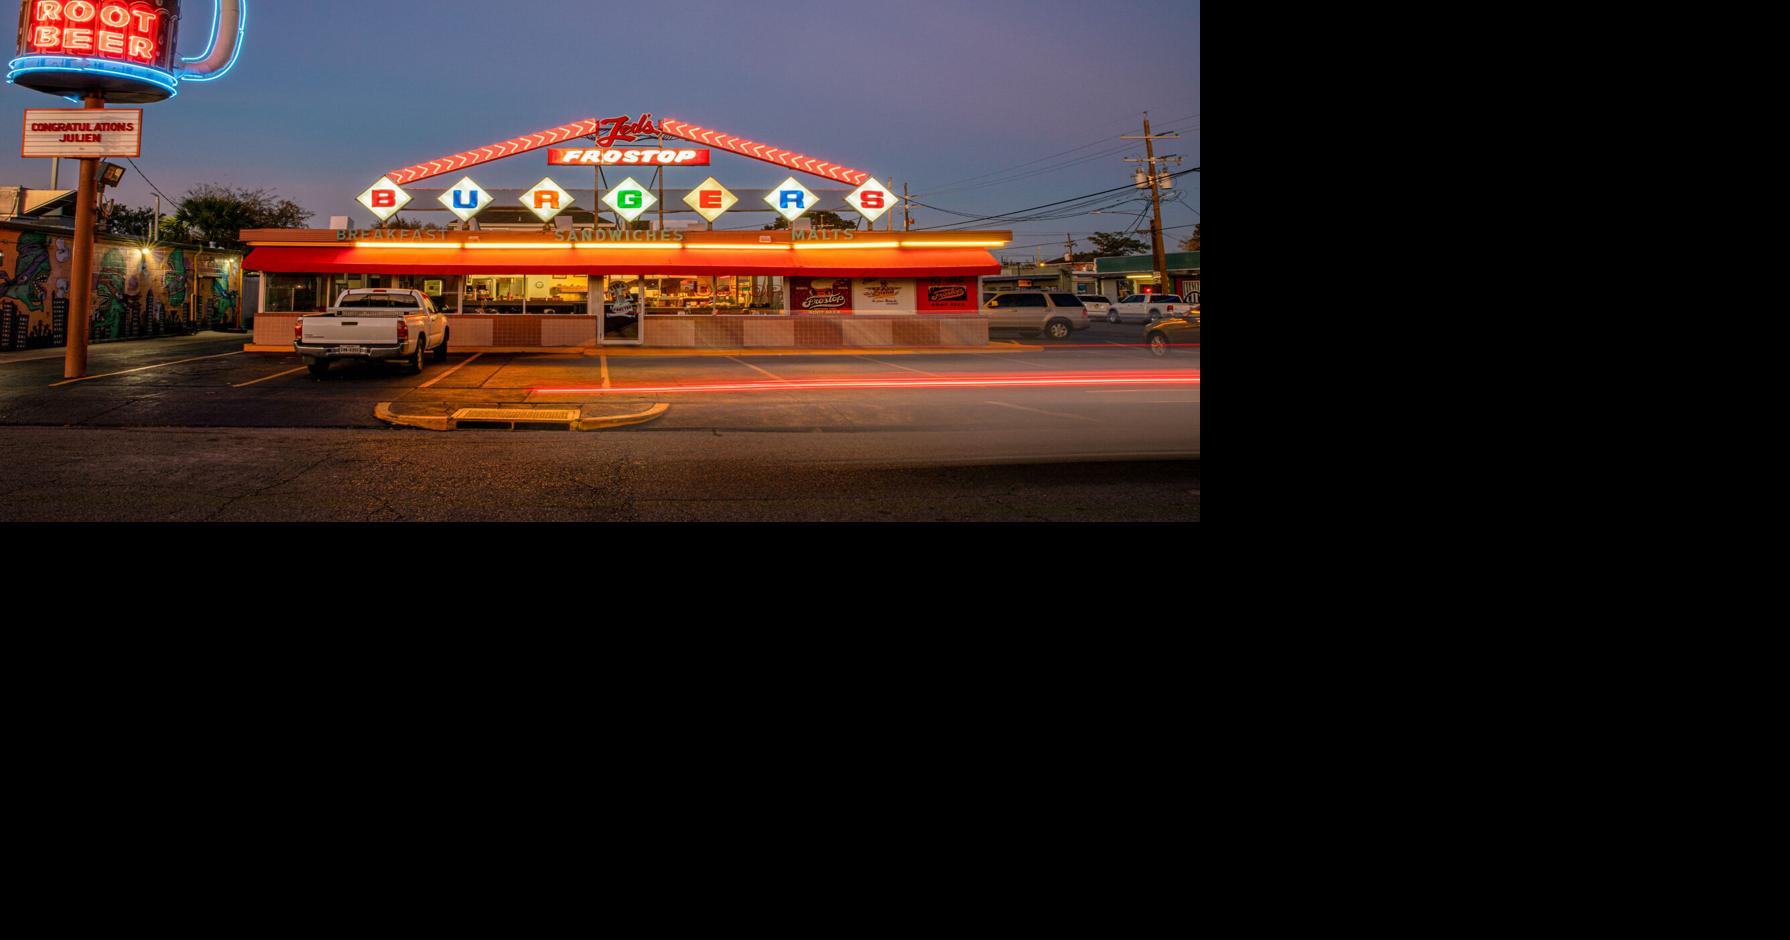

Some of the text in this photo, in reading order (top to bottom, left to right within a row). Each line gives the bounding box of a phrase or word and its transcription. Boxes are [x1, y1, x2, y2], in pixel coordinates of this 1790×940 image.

[36, 0, 157, 33] ROOT
[33, 25, 154, 60] BEER
[31, 122, 134, 132] CONGRATULATIONS
[596, 113, 661, 147] Ted's
[59, 133, 102, 143] JULIEN
[562, 149, 697, 163] FROSTOP
[371, 189, 885, 209] BURGERS
[336, 229, 449, 241] BREAKFAST
[554, 229, 684, 242] SANDWICHES
[791, 228, 855, 241] MALTS
[802, 292, 846, 310] Frostop
